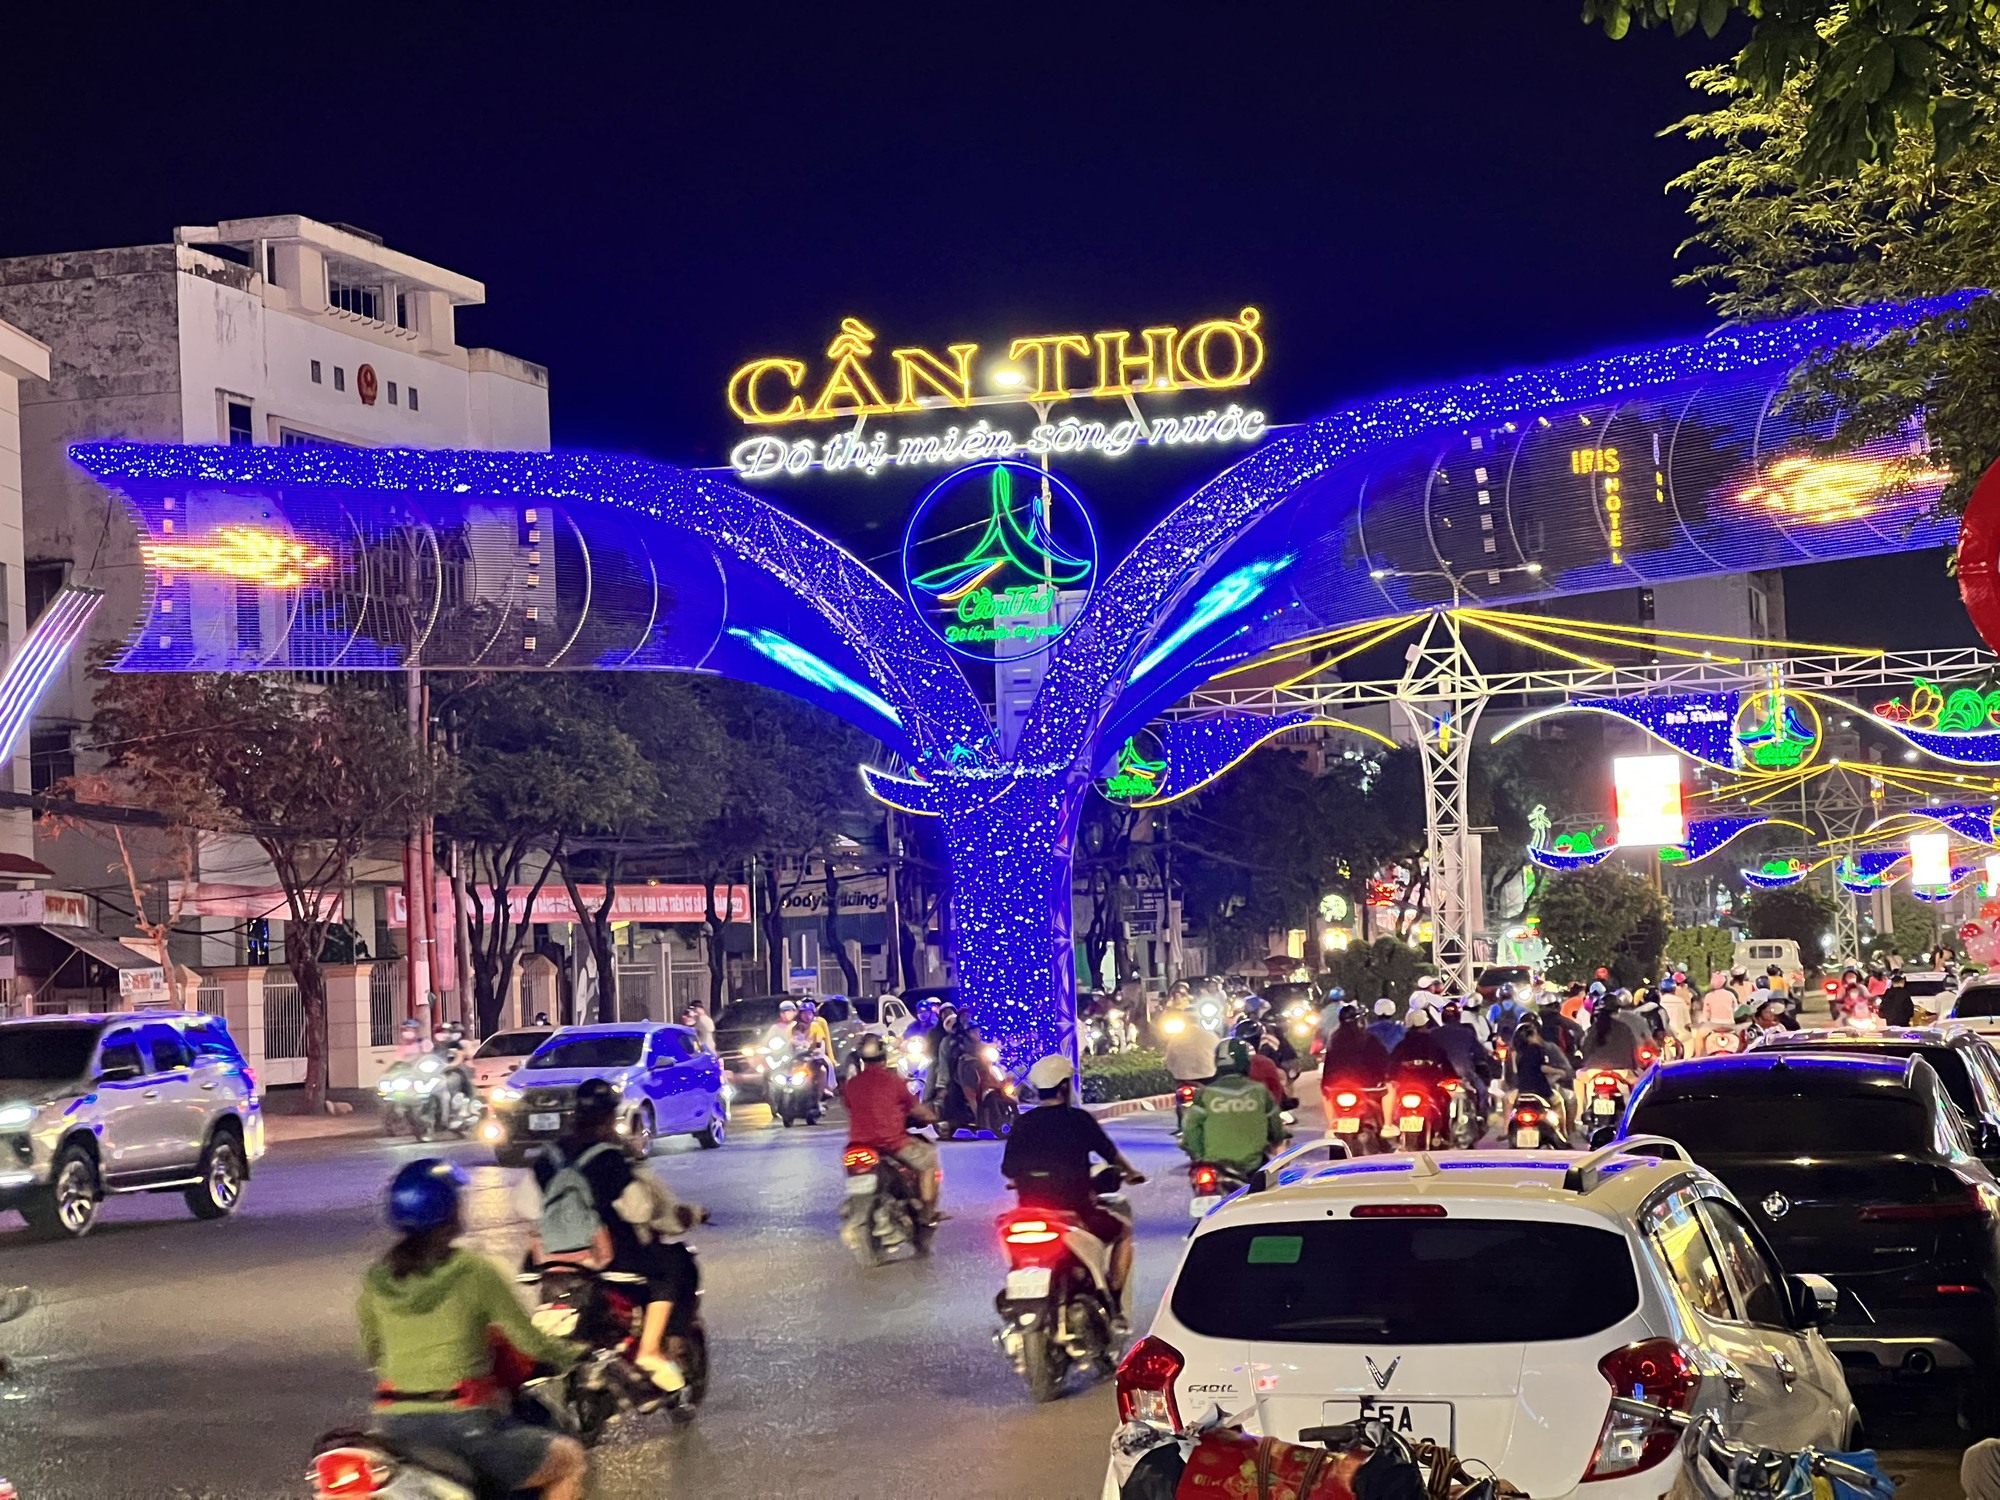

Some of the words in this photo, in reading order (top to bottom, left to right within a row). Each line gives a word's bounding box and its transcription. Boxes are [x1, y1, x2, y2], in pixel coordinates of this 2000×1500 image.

[727, 317, 978, 423] CẦN
[1009, 306, 1264, 402] THƠ
[731, 435, 817, 478] Đô
[822, 431, 888, 475] thị
[896, 419, 1016, 466] miền
[1027, 416, 1142, 456] sông
[1148, 403, 1266, 446] nước
[1571, 448, 1621, 474] IRIS
[1604, 477, 1622, 564] HOTEL
[1188, 1384, 1239, 1393] FADIL
